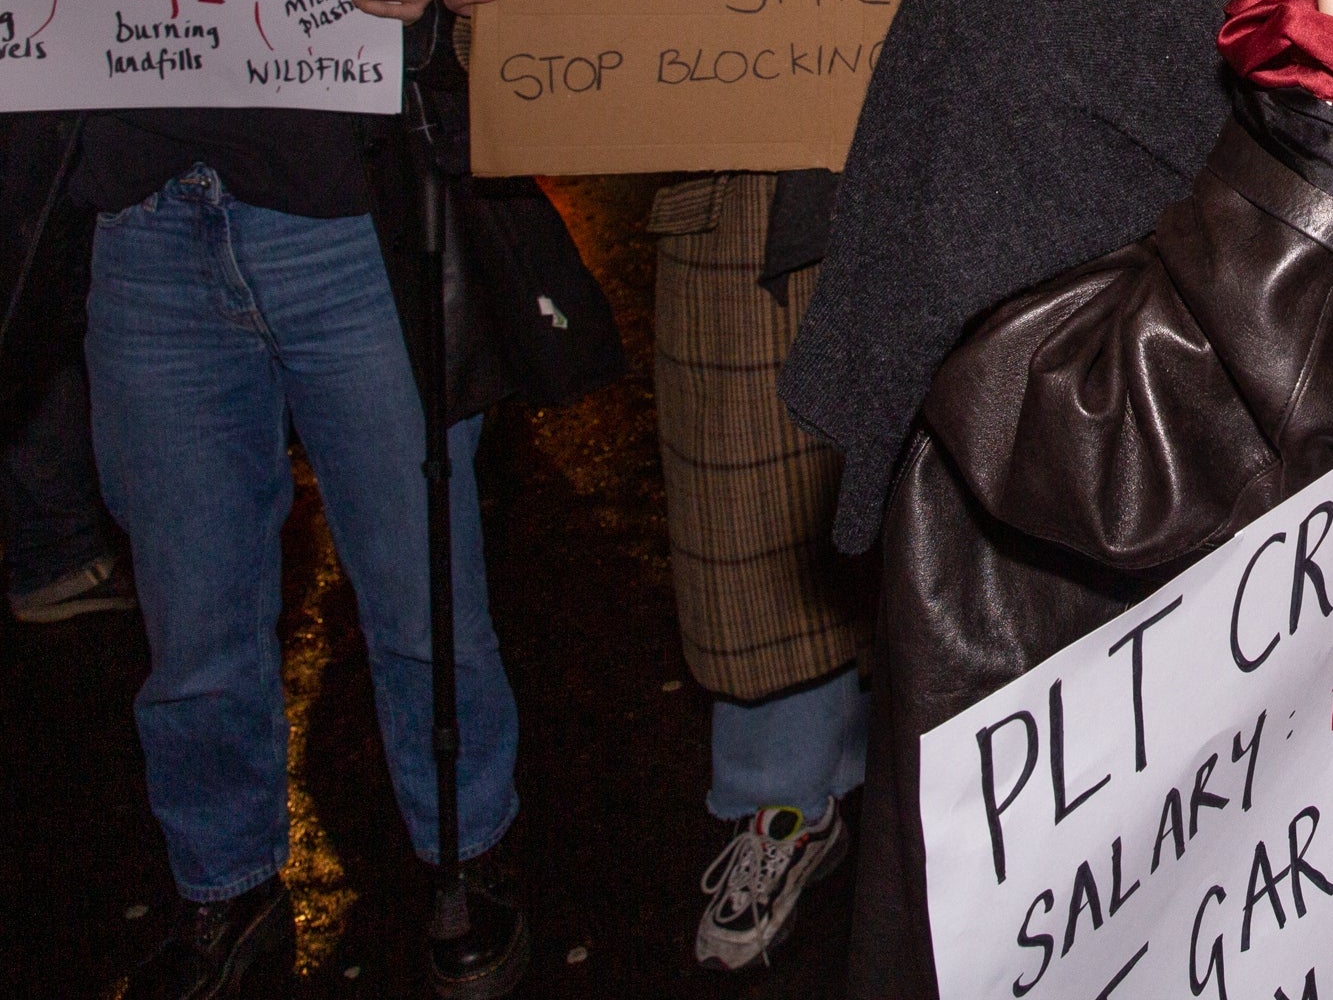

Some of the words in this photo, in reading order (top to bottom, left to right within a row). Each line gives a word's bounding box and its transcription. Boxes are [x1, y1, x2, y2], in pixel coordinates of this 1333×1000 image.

[115, 11, 220, 49] burning
[106, 48, 203, 80] landfills
[247, 57, 383, 85] WILDFIRES
[500, 51, 623, 101] STOP
[976, 595, 1182, 884] PLT
[1012, 709, 1296, 998] SALARY:
